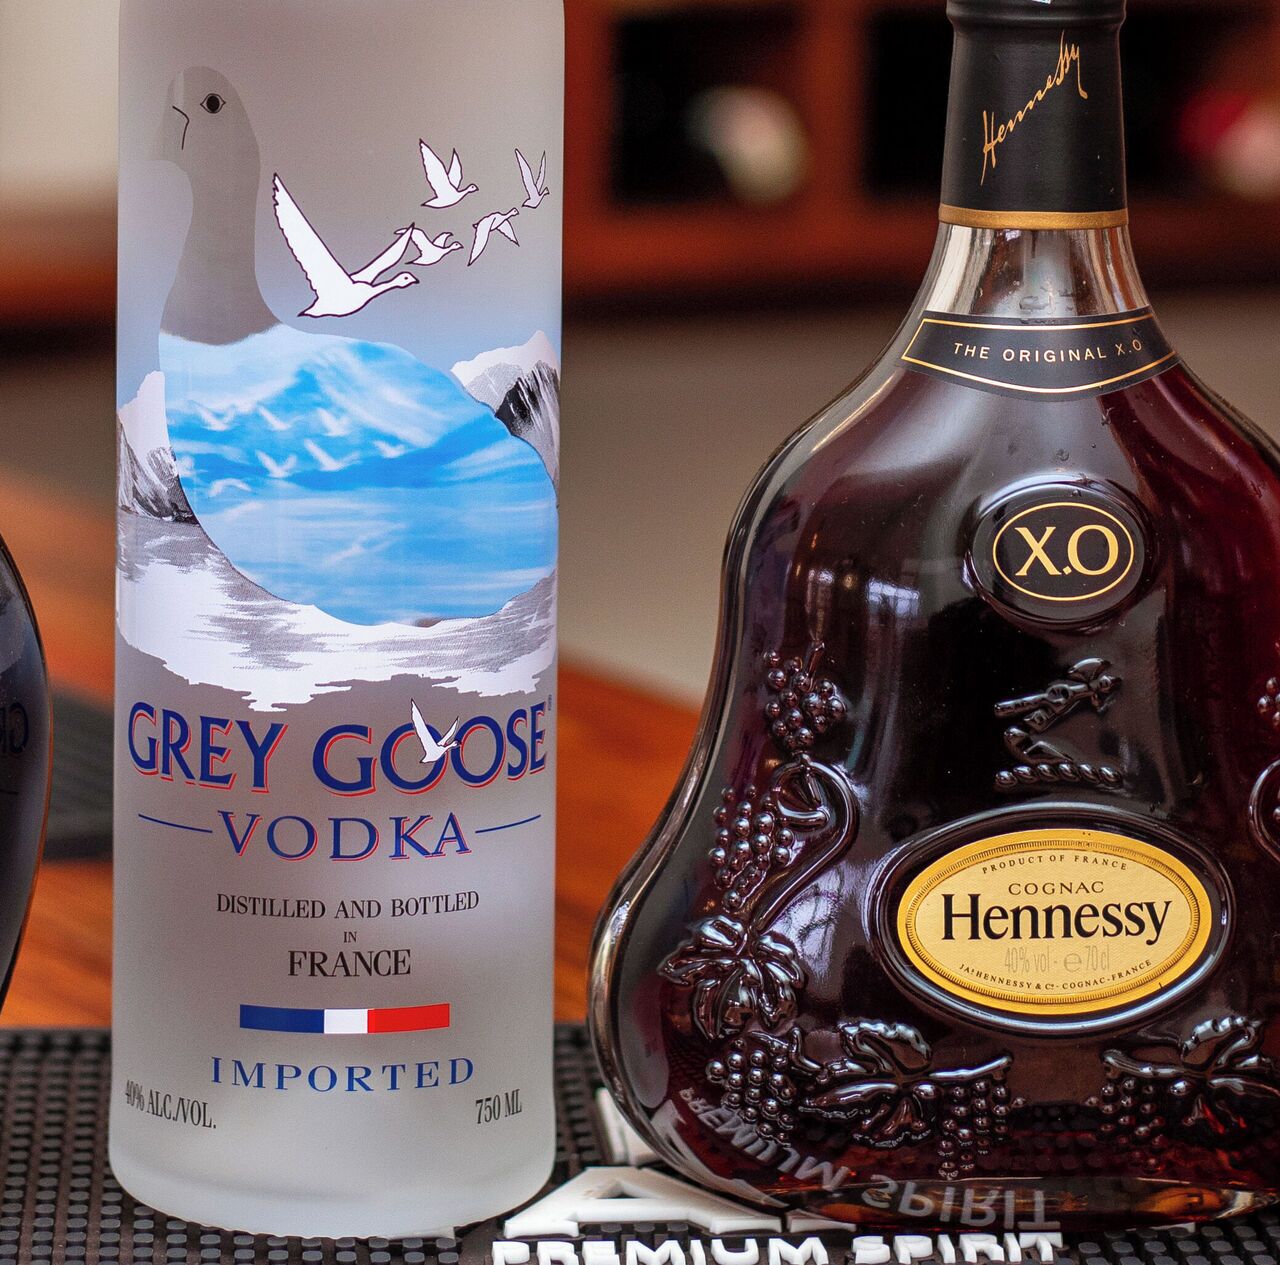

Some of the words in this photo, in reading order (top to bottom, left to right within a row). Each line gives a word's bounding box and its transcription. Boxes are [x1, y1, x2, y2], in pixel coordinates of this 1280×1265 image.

[953, 342, 990, 360] THE
[1002, 346, 1107, 363] ORIGINAL
[1014, 523, 1119, 576] X.O
[127, 701, 290, 794] GREY
[216, 809, 473, 862] VODKA
[981, 855, 1044, 875] PRODUCT
[1049, 853, 1066, 863] OF
[1074, 854, 1128, 872] FRANCE
[1007, 880, 1105, 896] COGNAC
[216, 892, 326, 919] DISTILLED
[333, 899, 382, 919] AND
[390, 890, 480, 917] BOTTLED
[940, 893, 1173, 946] Hennessy
[342, 930, 358, 944] IN
[287, 948, 412, 977] FRANCE
[1004, 946, 1031, 974] 40%
[1033, 944, 1050, 972] vol
[976, 971, 1032, 989] HENNESSY
[1035, 982, 1042, 990] &
[210, 1056, 475, 1093] IMPORTED
[474, 1095, 501, 1126] 750
[503, 1088, 523, 1118] ML
[852, 1232, 1064, 1265] SPIRIT
